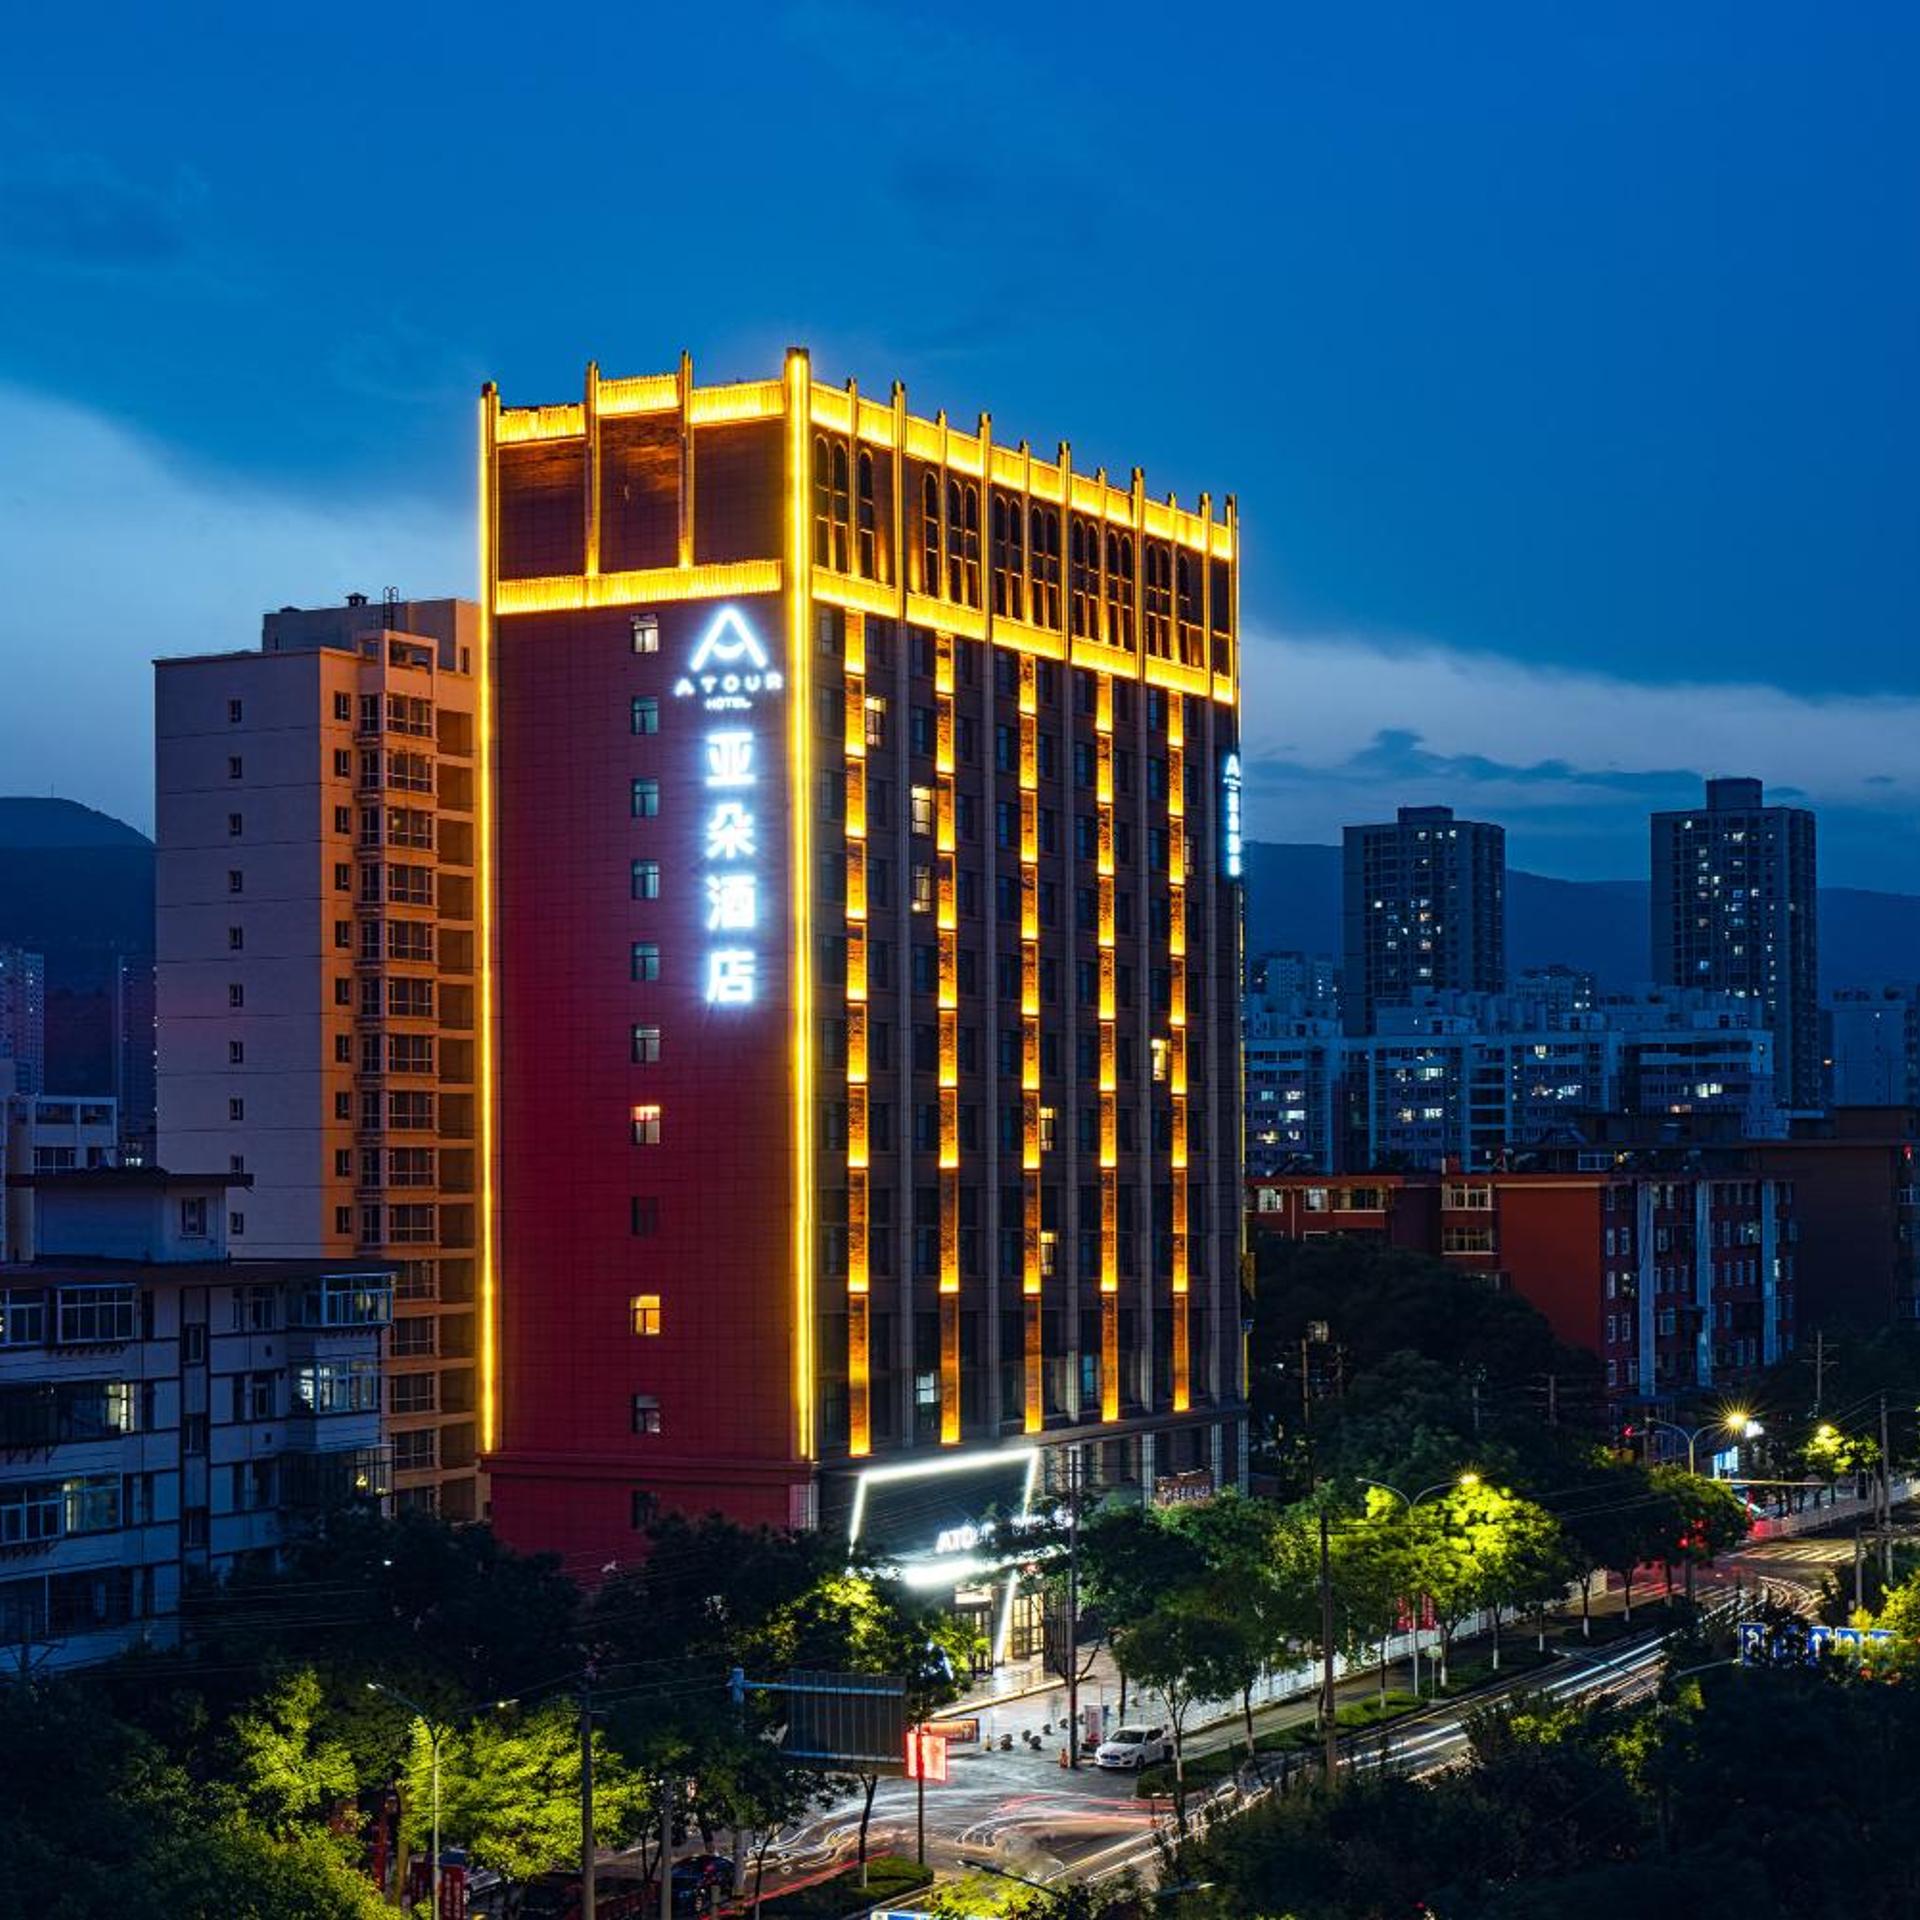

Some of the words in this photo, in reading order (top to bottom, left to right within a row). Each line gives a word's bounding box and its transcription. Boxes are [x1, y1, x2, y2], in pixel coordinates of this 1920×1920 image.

[674, 670, 783, 697] ATOUR
[704, 696, 752, 710] HOTEL
[705, 730, 756, 1003] 亚朵酒店
